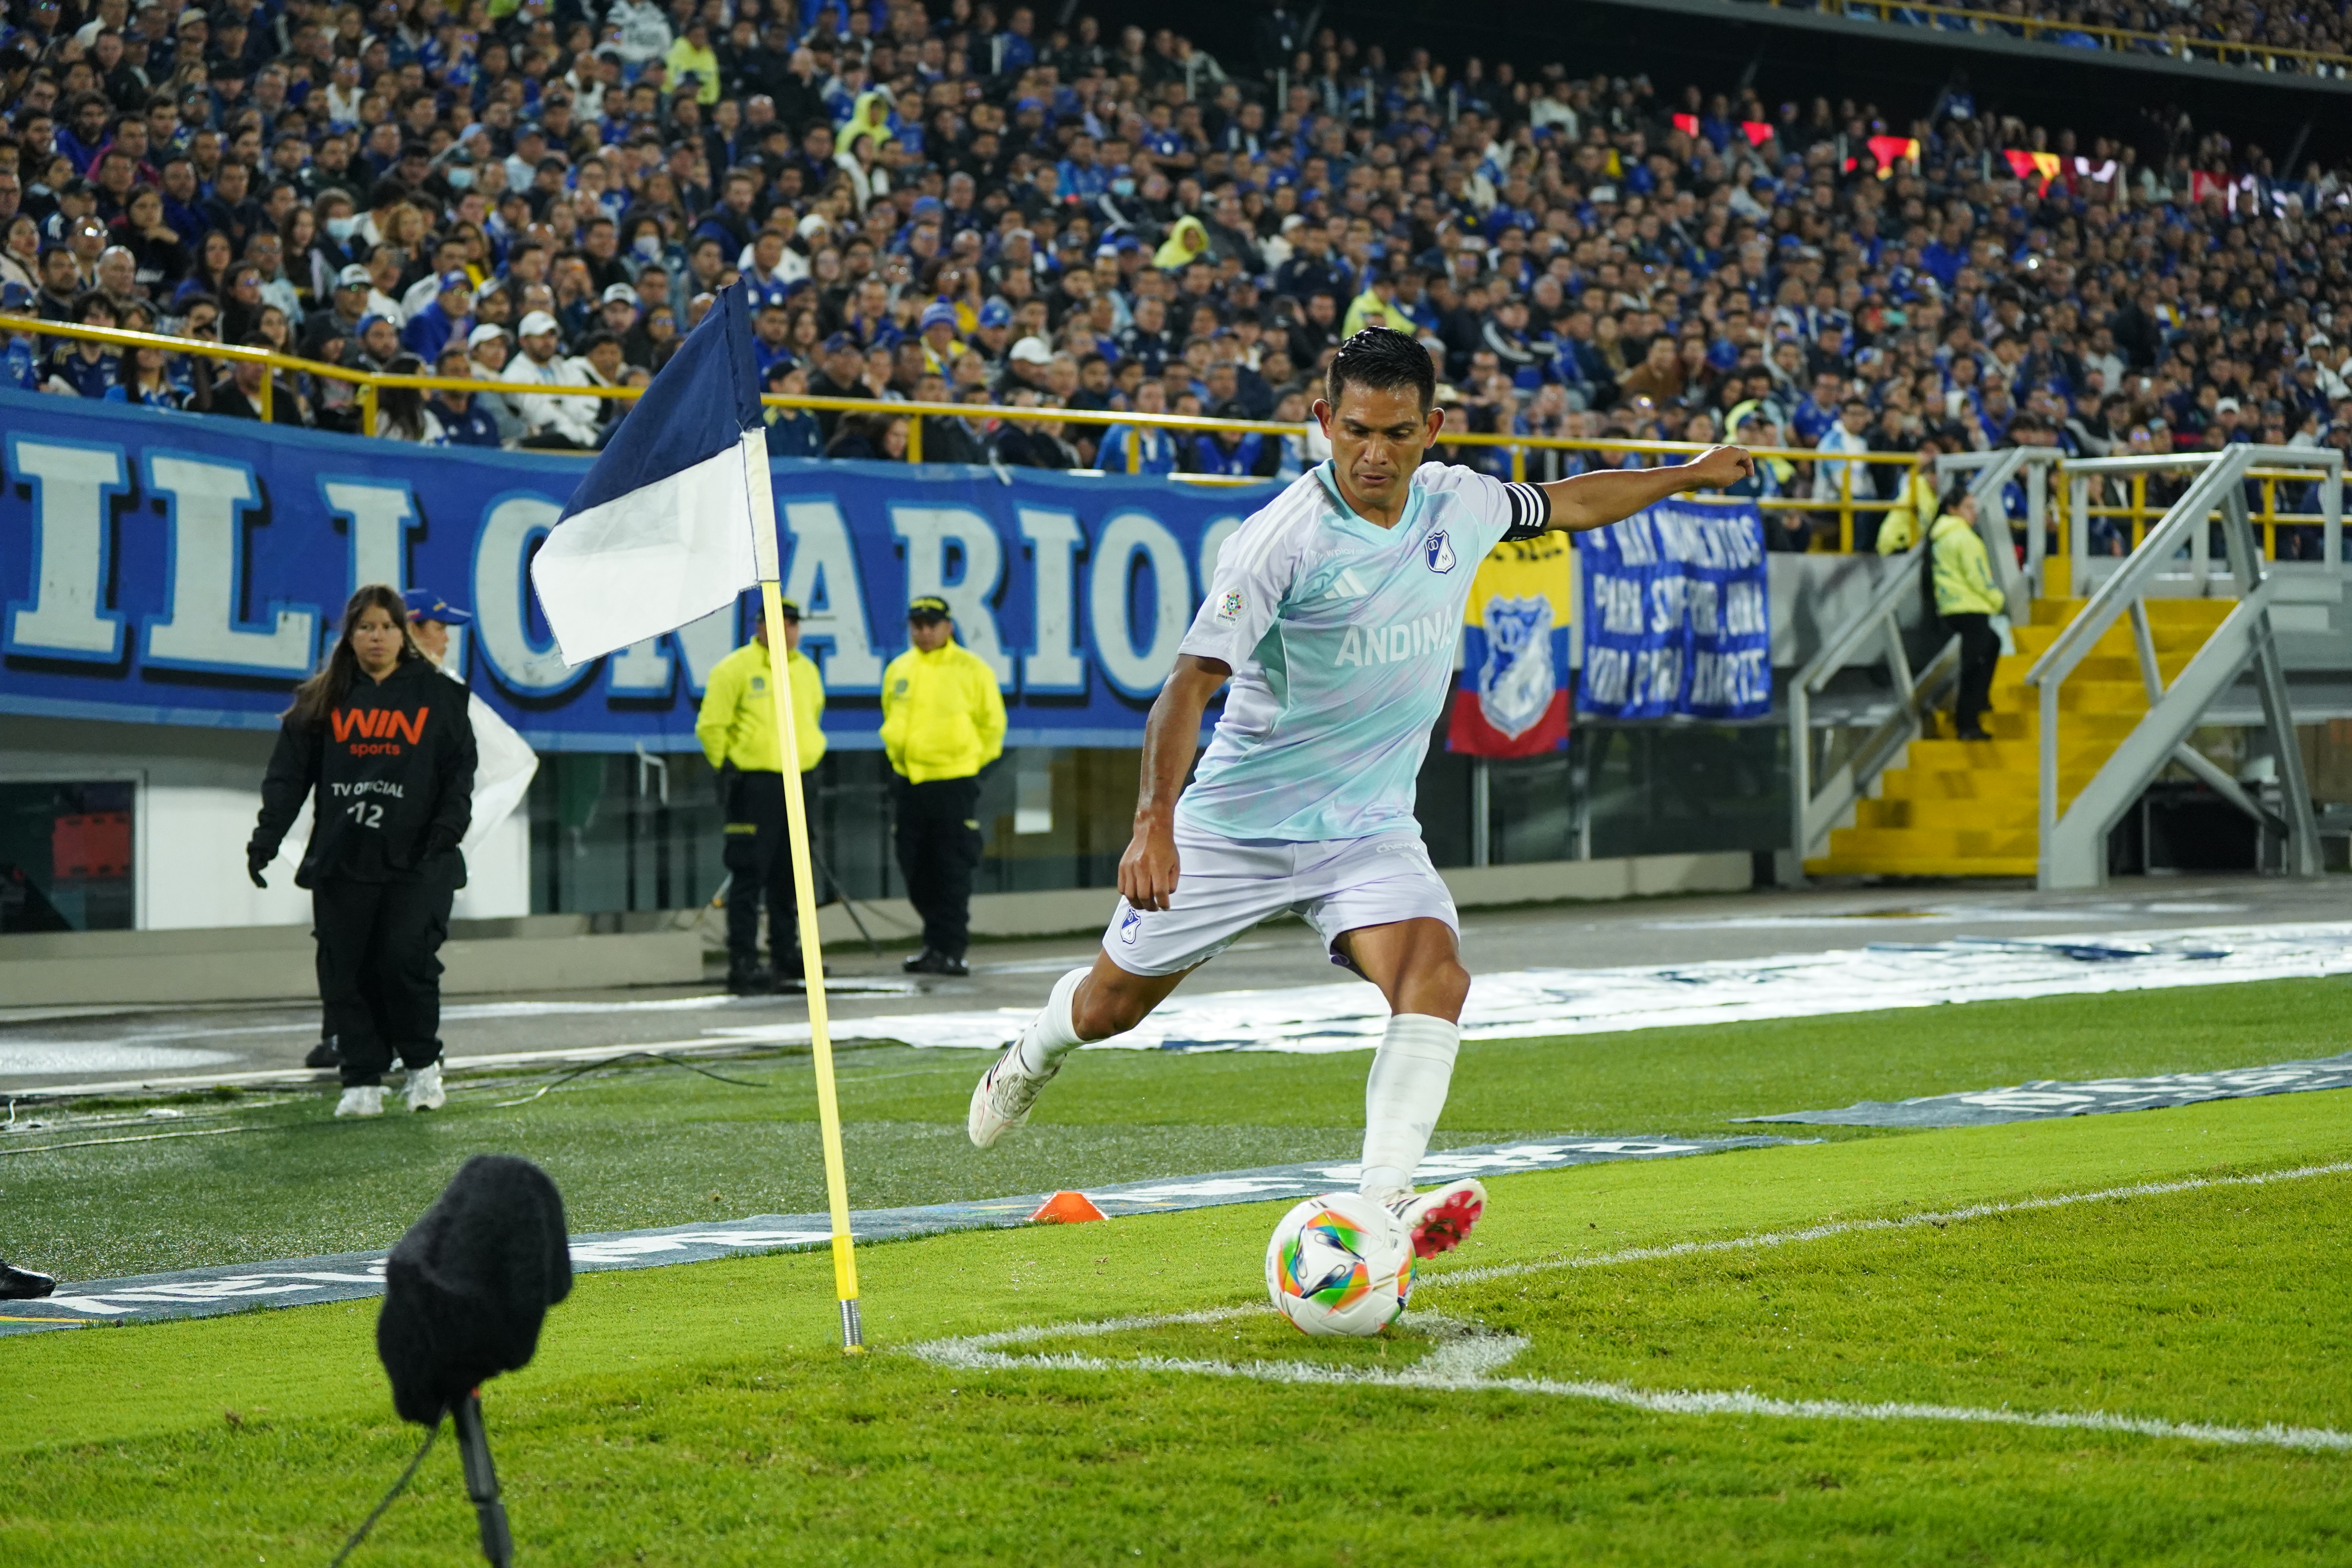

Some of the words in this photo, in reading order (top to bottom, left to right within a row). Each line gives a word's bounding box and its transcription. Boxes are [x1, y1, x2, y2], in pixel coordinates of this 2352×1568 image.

[1217, 613, 1236, 622] DIMAYOR
[1334, 603, 1453, 666] ANDINA
[331, 707, 429, 744] WIN
[350, 743, 400, 757] sports
[331, 783, 351, 797] TV
[347, 801, 384, 828] 12
